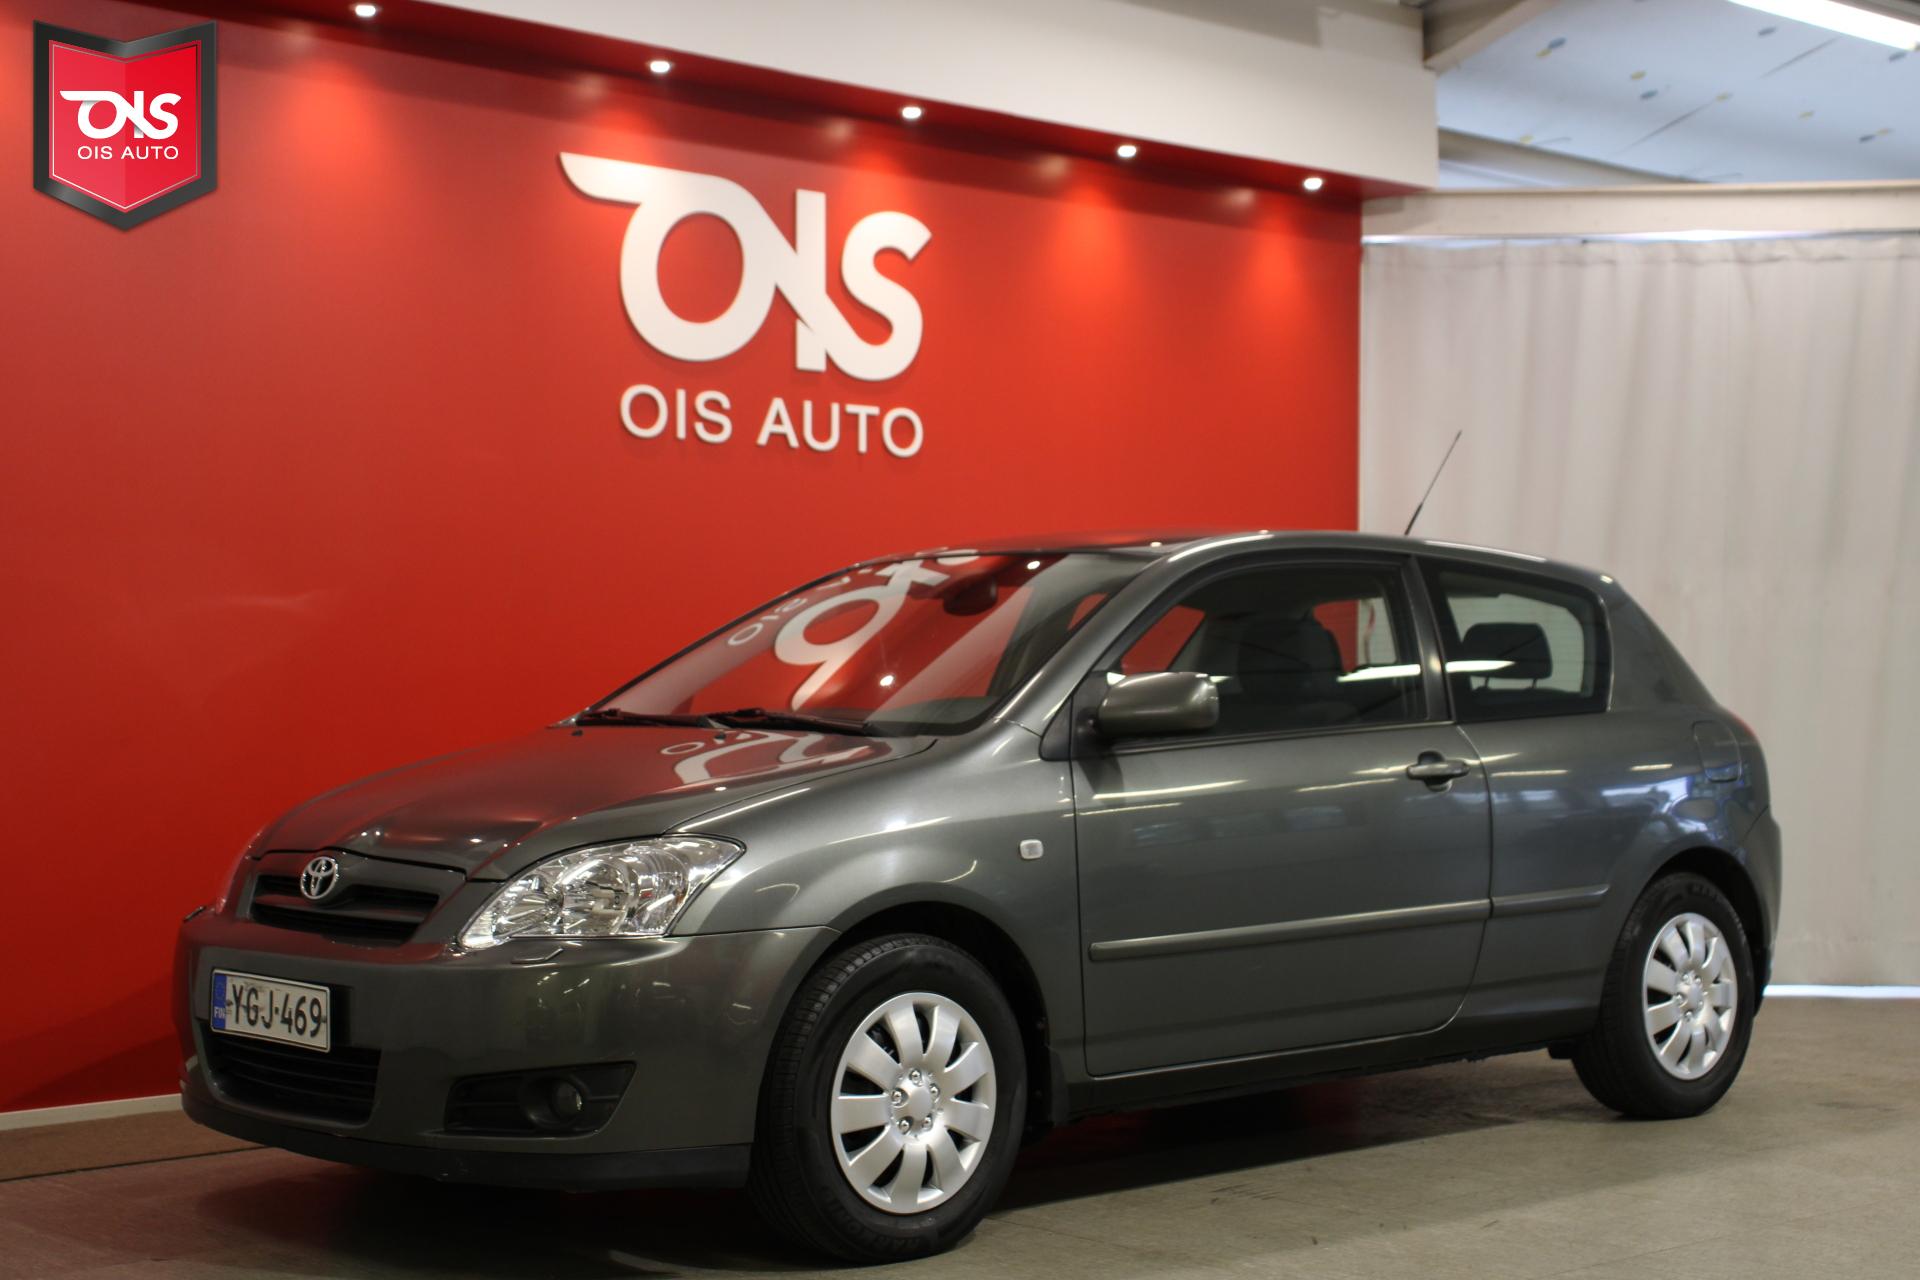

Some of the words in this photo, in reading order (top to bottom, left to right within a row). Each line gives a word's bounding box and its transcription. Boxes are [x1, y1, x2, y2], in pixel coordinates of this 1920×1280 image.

[620, 384, 732, 443] OIS
[756, 397, 924, 458] AUTO
[232, 983, 322, 1038] YGJ-469
